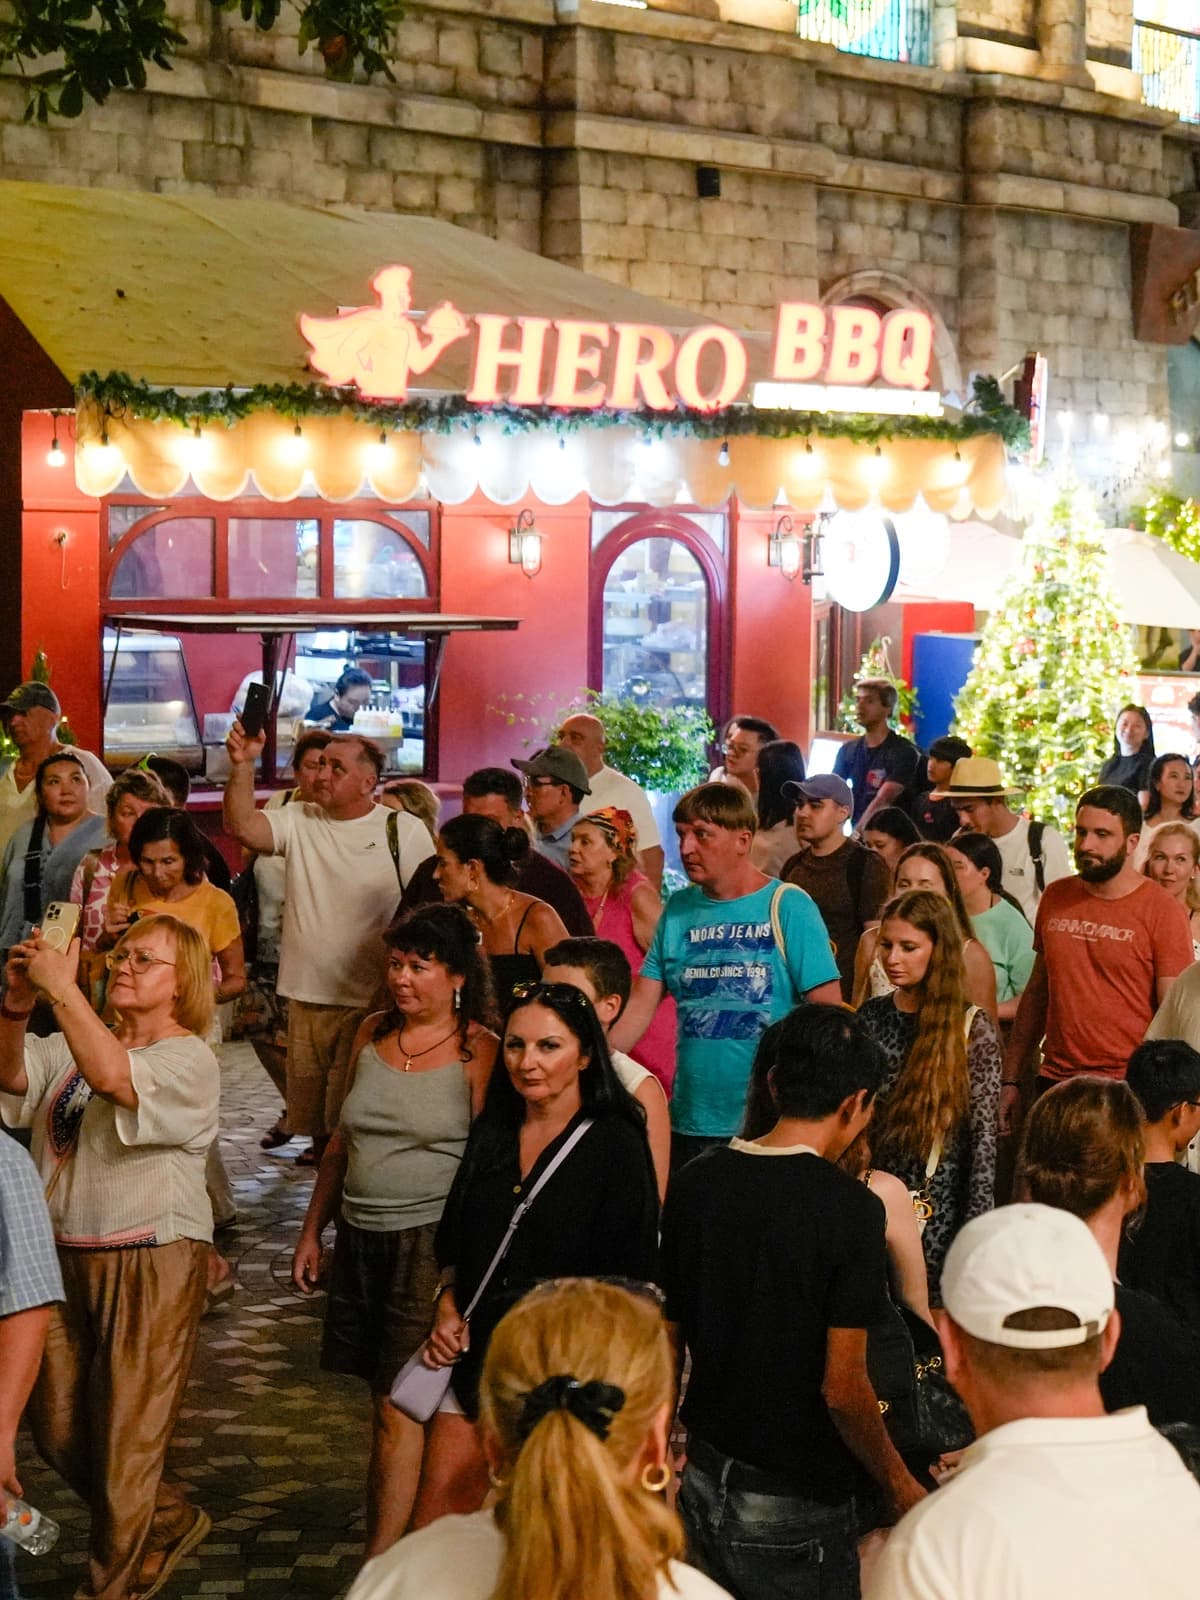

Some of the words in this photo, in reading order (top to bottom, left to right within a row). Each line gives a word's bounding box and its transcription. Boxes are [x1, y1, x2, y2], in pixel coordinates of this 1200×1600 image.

[466, 313, 748, 413] HERO
[773, 302, 935, 390] BBQ
[729, 922, 771, 939] JEANS
[746, 966, 767, 978] 1994
